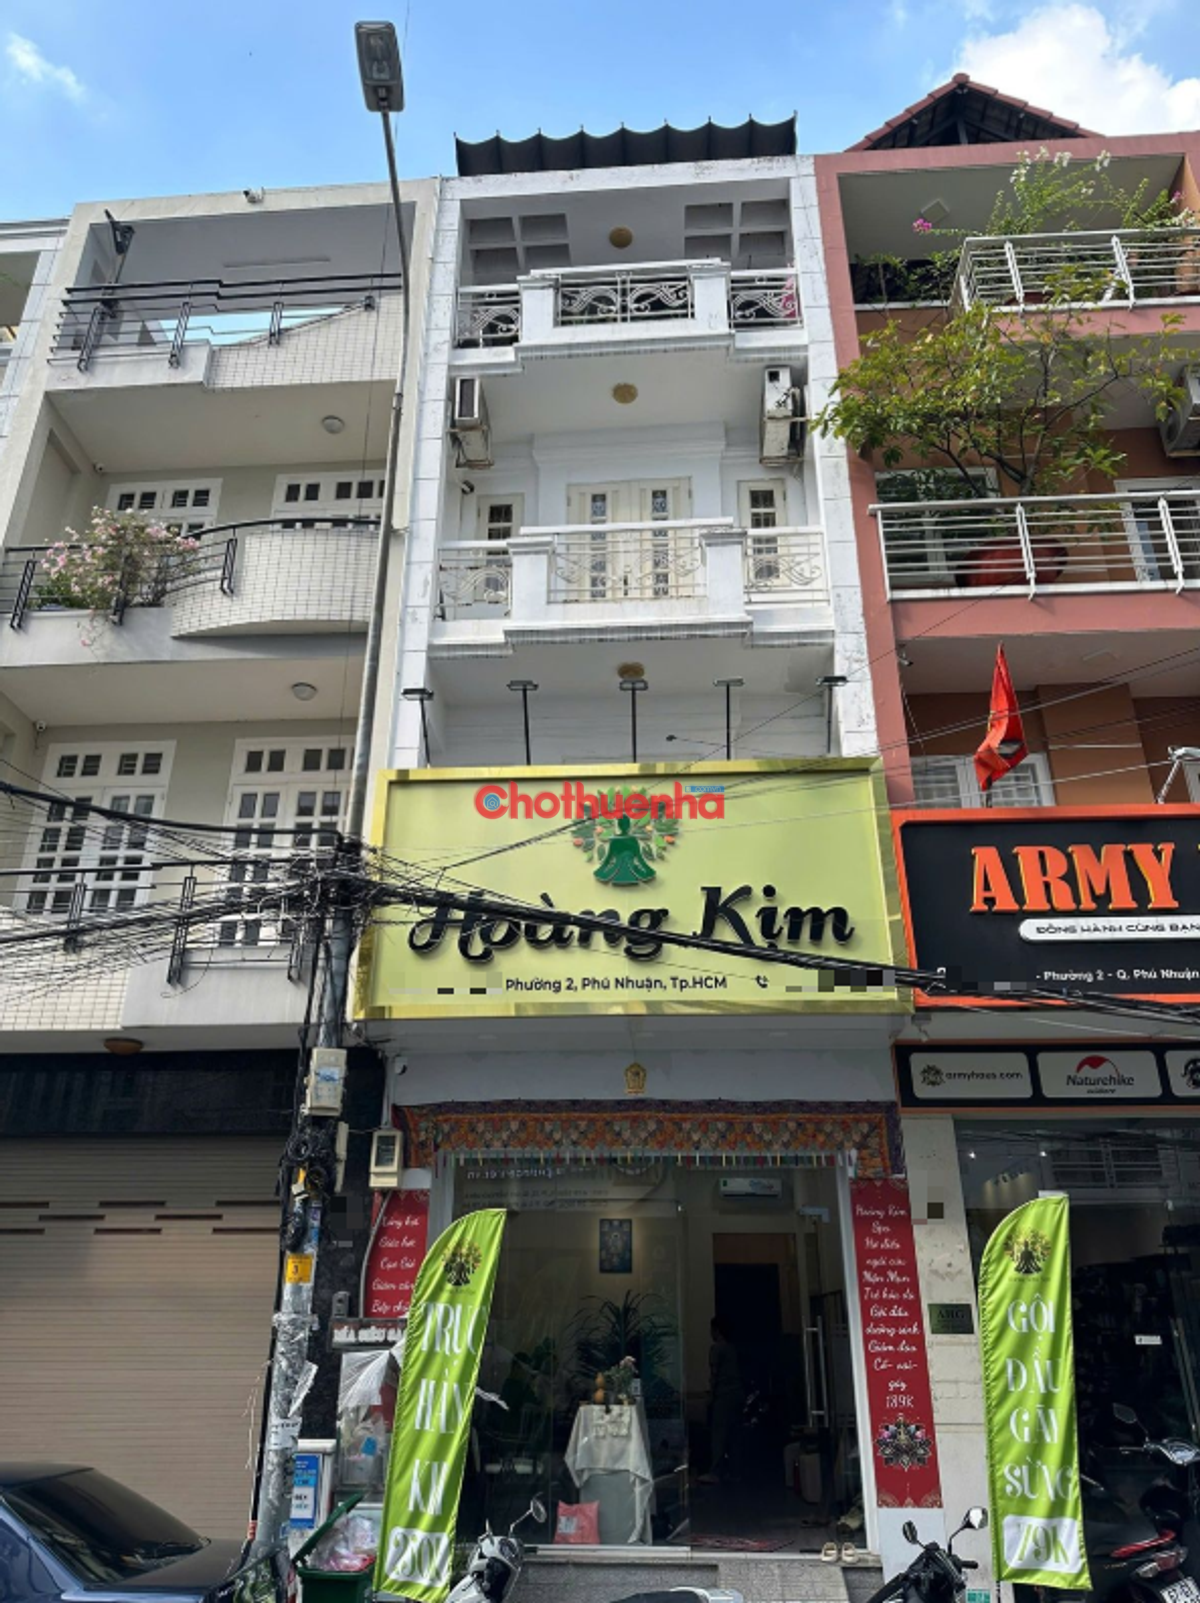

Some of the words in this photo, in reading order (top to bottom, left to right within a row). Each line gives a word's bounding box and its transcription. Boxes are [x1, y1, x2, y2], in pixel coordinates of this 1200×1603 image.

[970, 842, 1179, 912] ARMY
[408, 890, 670, 963] Hoàng
[700, 884, 855, 948] Kim
[506, 978, 562, 993] Phường
[565, 977, 578, 992] 2,
[581, 976, 610, 990] Phú
[614, 976, 667, 992] Nhuận,
[669, 976, 728, 992] Tp.HCM
[1043, 970, 1093, 983] Phường
[1096, 970, 1104, 981] 2
[1116, 969, 1130, 980] Q.
[1133, 967, 1157, 980] Phú
[1066, 1074, 1135, 1086] Naturehike
[1007, 1293, 1056, 1341] GỘI
[1006, 1347, 1062, 1394] ĐẦU
[1017, 1522, 1070, 1565] 79K
